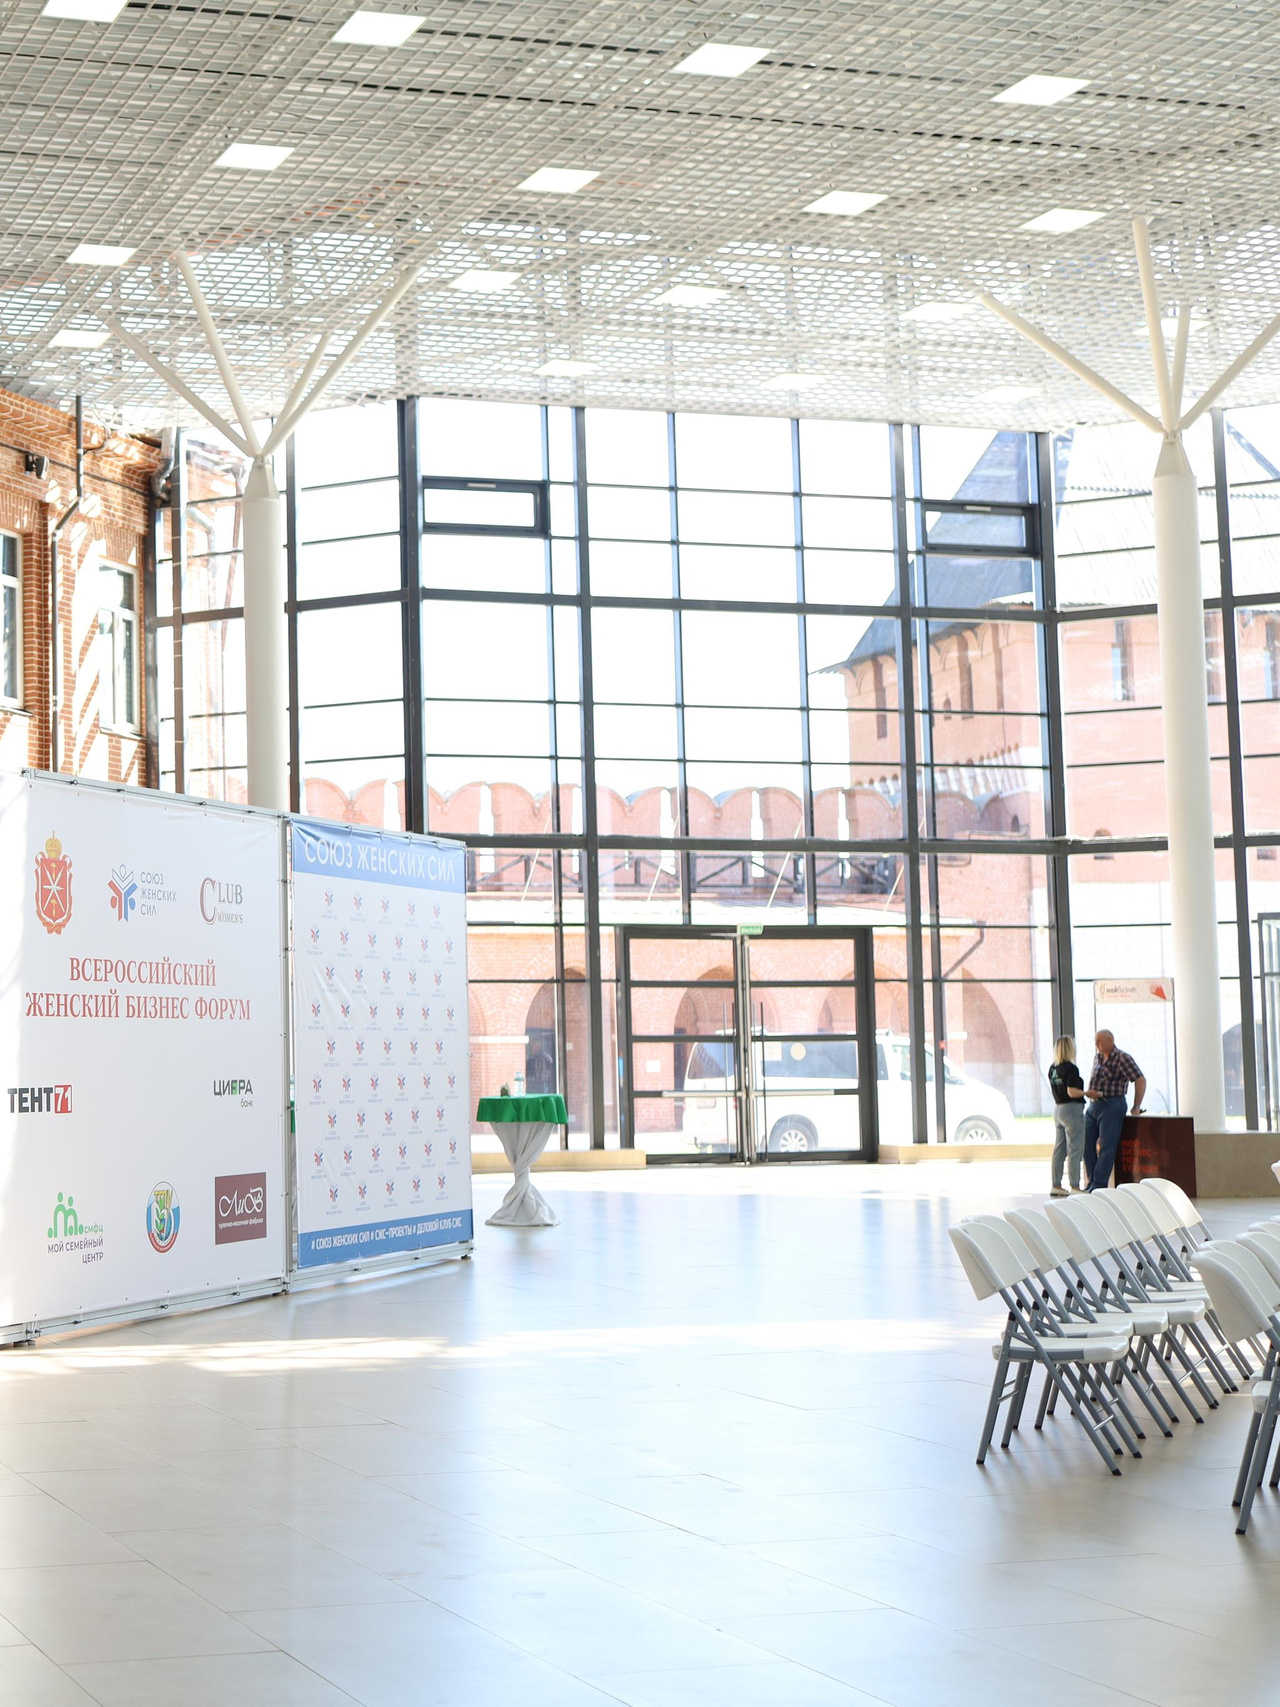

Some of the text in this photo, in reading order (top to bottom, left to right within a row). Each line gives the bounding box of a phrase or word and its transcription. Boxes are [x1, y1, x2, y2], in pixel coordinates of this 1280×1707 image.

[305, 837, 456, 882] СОЮЗ ЖЕНСКИХ СИЛ
[140, 872, 164, 885] СОЮЗ
[140, 888, 177, 902] ЖЕНСКИХ
[200, 877, 243, 926] CLUB
[140, 904, 158, 916] СИЛ
[69, 956, 217, 987] ВСЕРОССИЙСКИЙ
[25, 988, 251, 1021] ЖЕНСКИЙ БИЗНЕС ФОРУМ
[240, 1098, 254, 1108] банк
[48, 1236, 104, 1254] МОЙ СЕМЕЙНЫЙ
[316, 1238, 332, 1250] СОЮЗ
[332, 1233, 358, 1248] ЖЕНСКИХ
[360, 1232, 370, 1244] СИЛ
[82, 1252, 104, 1264] ЦЕНТР
